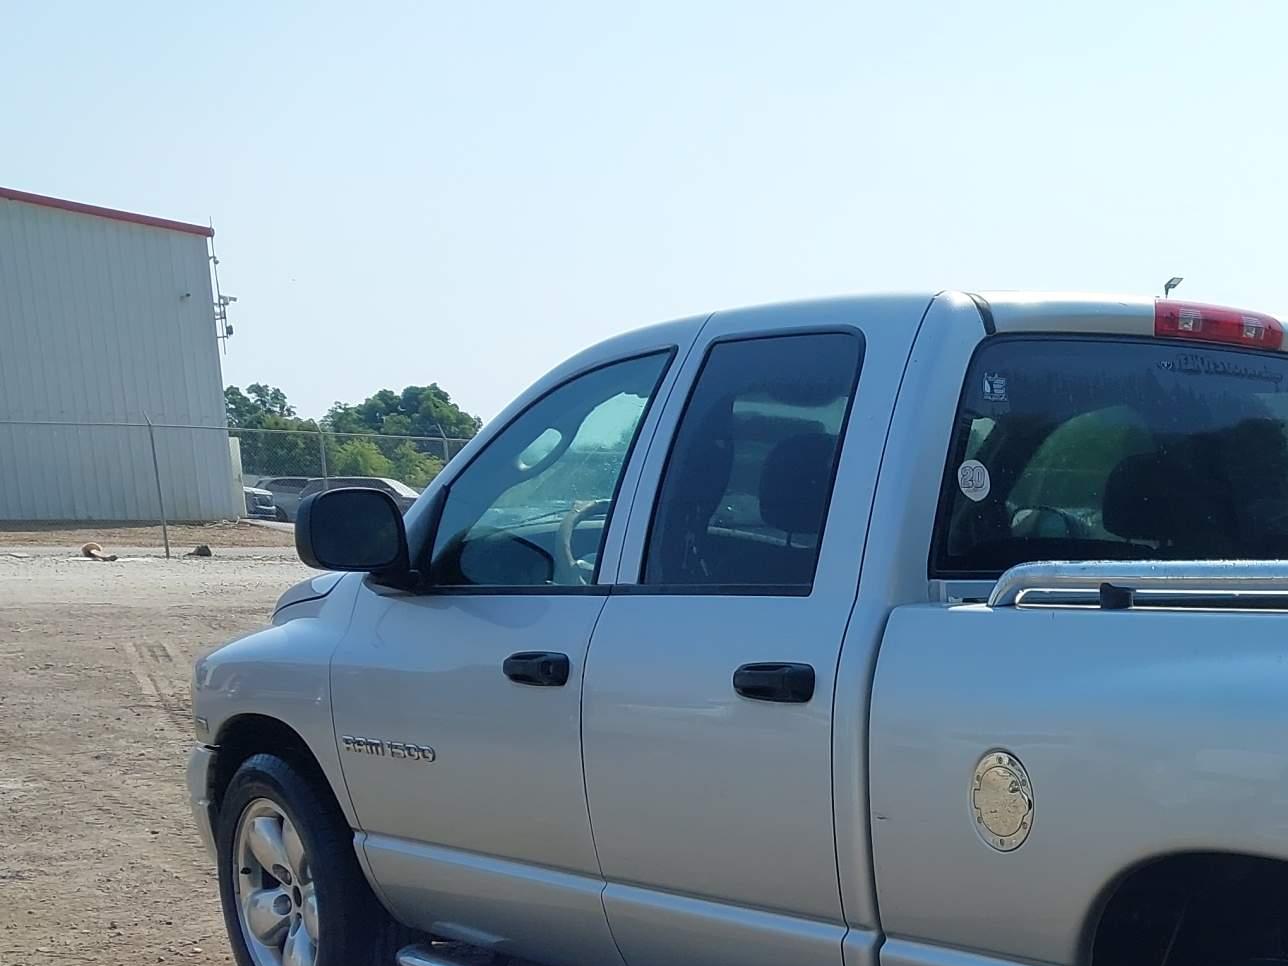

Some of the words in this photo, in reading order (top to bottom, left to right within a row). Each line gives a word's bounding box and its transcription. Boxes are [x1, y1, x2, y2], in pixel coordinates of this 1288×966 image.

[961, 465, 986, 488] 20
[342, 735, 384, 757] RAM
[386, 740, 436, 762] 1500
